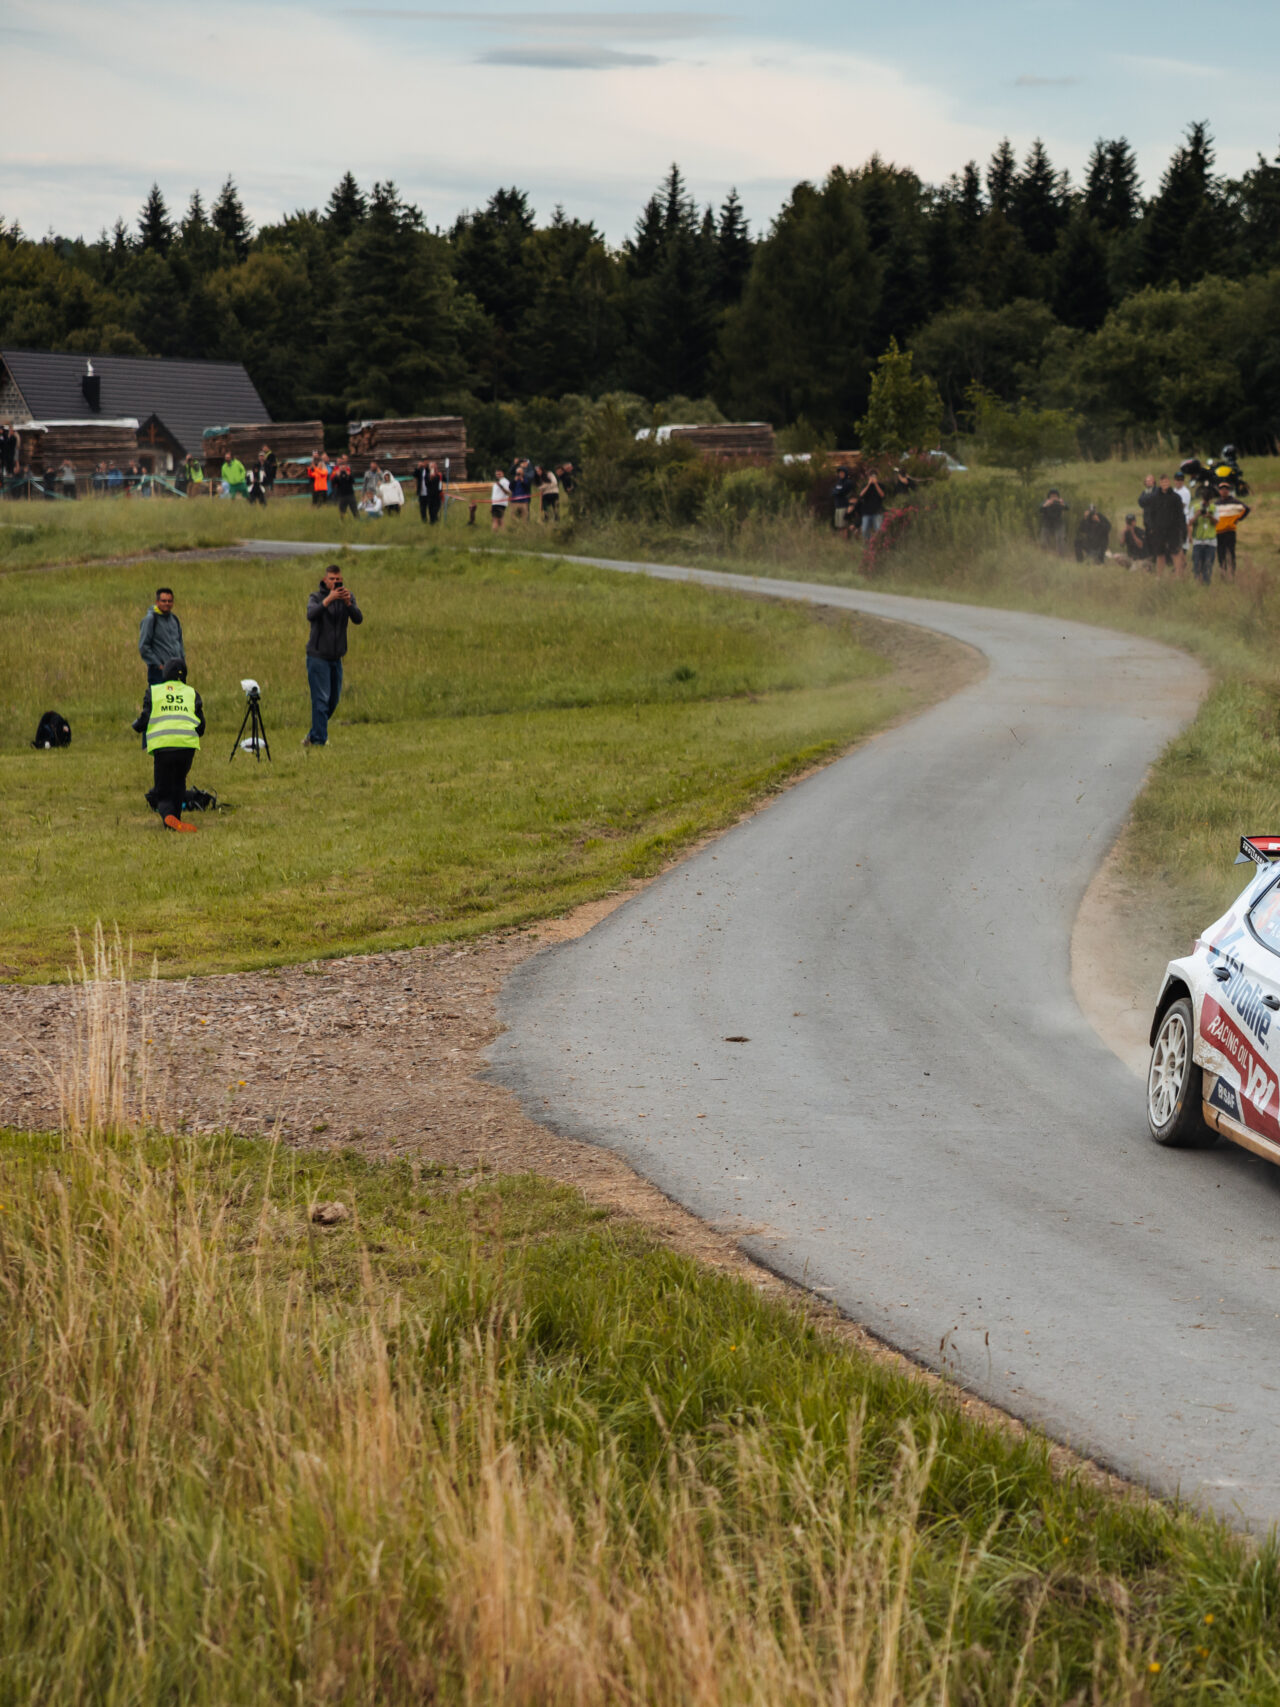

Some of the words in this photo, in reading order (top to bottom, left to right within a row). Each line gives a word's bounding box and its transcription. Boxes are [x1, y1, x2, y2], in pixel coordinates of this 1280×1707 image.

[165, 694, 184, 704] 95
[1207, 1015, 1239, 1055] RACING
[1238, 1045, 1249, 1069] OIL
